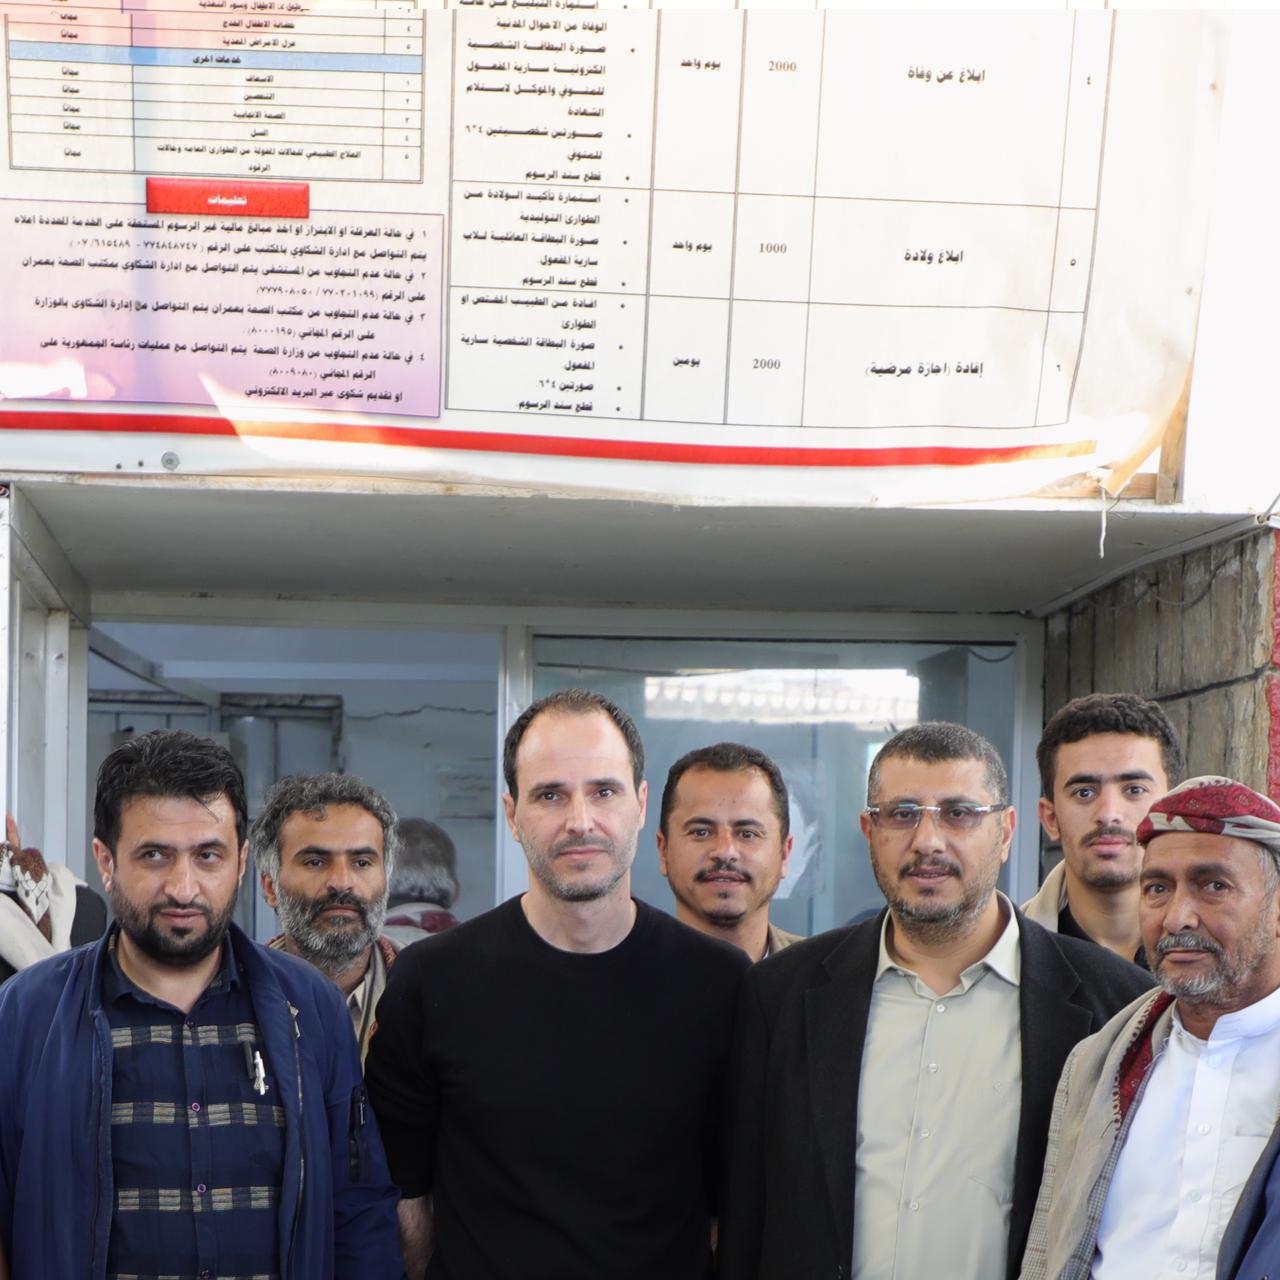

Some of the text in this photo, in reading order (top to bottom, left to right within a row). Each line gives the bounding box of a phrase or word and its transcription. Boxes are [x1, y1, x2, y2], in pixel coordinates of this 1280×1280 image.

[217, 56, 241, 64] خدمات
[680, 57, 721, 70] يوم واحد
[768, 60, 798, 73] 2000
[907, 65, 986, 84] ابلاغ عن وفاة
[207, 191, 248, 209] تعليمات
[72, 216, 102, 226] الخدمة
[105, 218, 123, 230] على
[168, 221, 200, 231] الرسوم
[203, 221, 216, 232] غير
[221, 223, 243, 231] مالية
[248, 224, 272, 234] مبالغ
[384, 229, 402, 237] حالة
[406, 230, 414, 240] في
[672, 239, 713, 253] يوم واحد
[759, 242, 787, 254] 1000
[904, 248, 964, 264] ابلاغ ولادة
[299, 329, 375, 341] على الرقم المجاني
[672, 356, 701, 368] يومين
[752, 358, 781, 371] 2000
[955, 361, 983, 377] إفادة
[518, 399, 593, 412] قطع سند الرسوم
